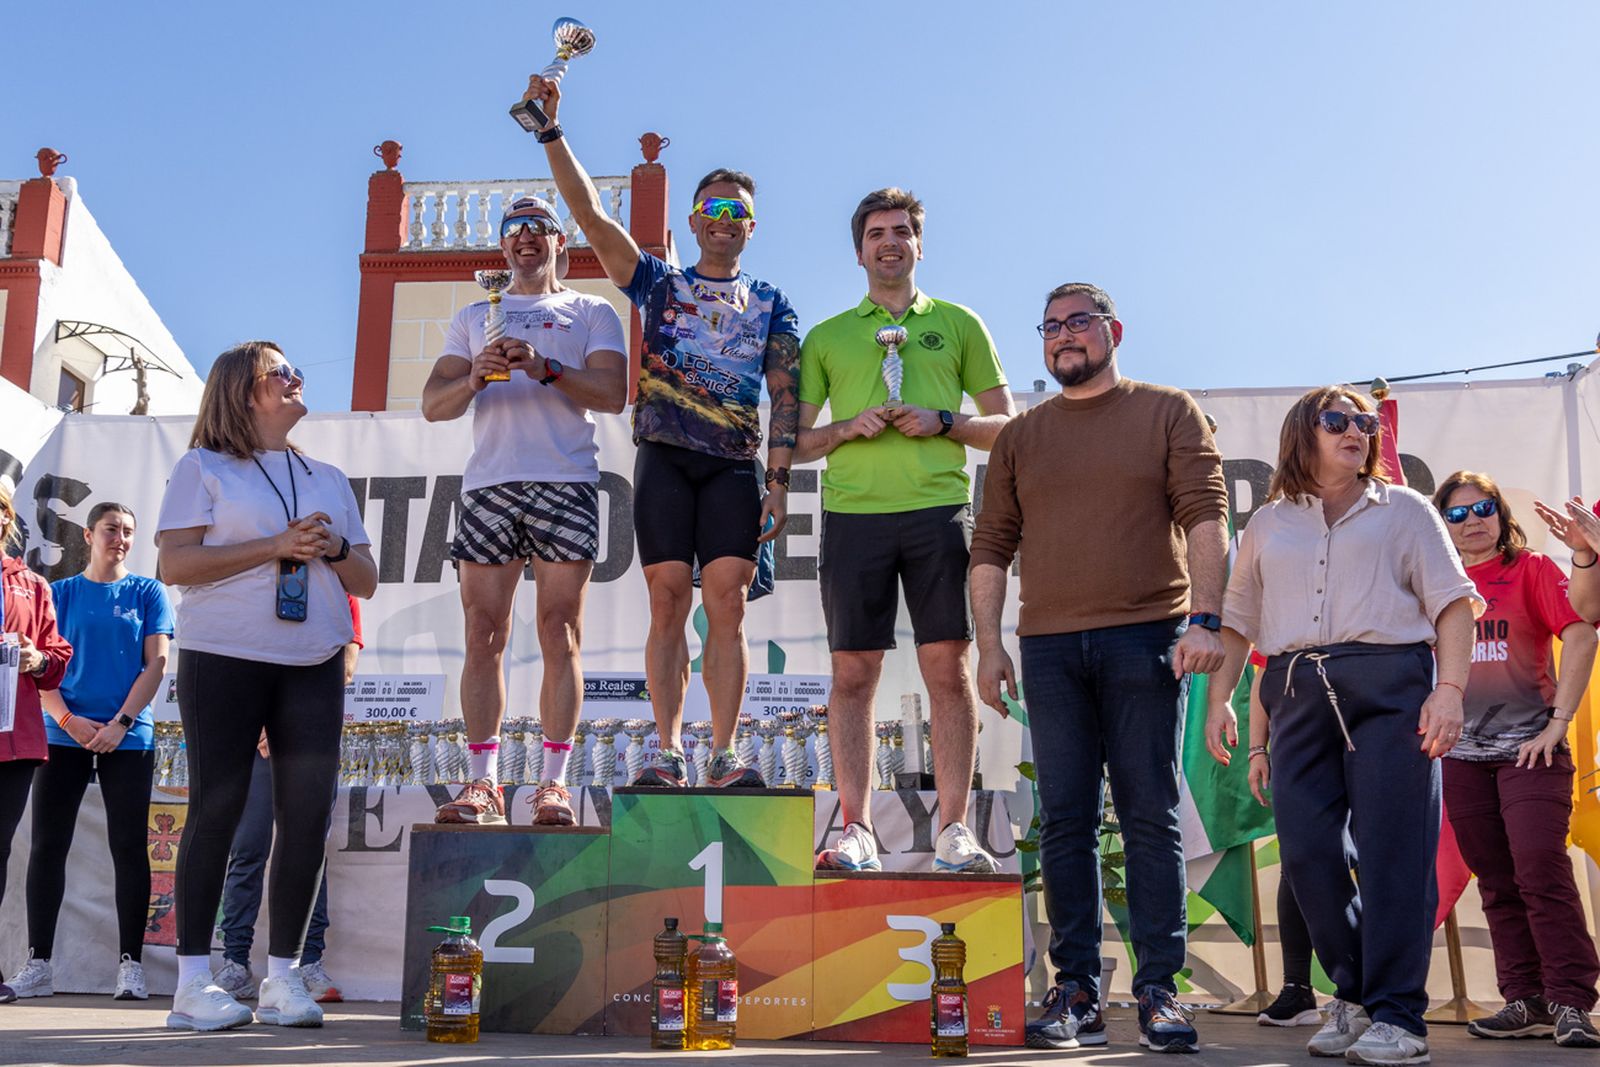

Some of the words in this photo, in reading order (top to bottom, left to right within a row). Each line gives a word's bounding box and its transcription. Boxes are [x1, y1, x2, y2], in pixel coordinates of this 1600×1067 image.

[1476, 619, 1509, 640] ANO
[1472, 641, 1509, 662] RAS
[600, 680, 635, 691] Reales
[365, 707, 406, 719] 300,00
[409, 707, 417, 717] €
[688, 841, 723, 924] 1
[481, 880, 535, 963] 2
[886, 915, 941, 1000] 3
[613, 993, 650, 1004] CONC
